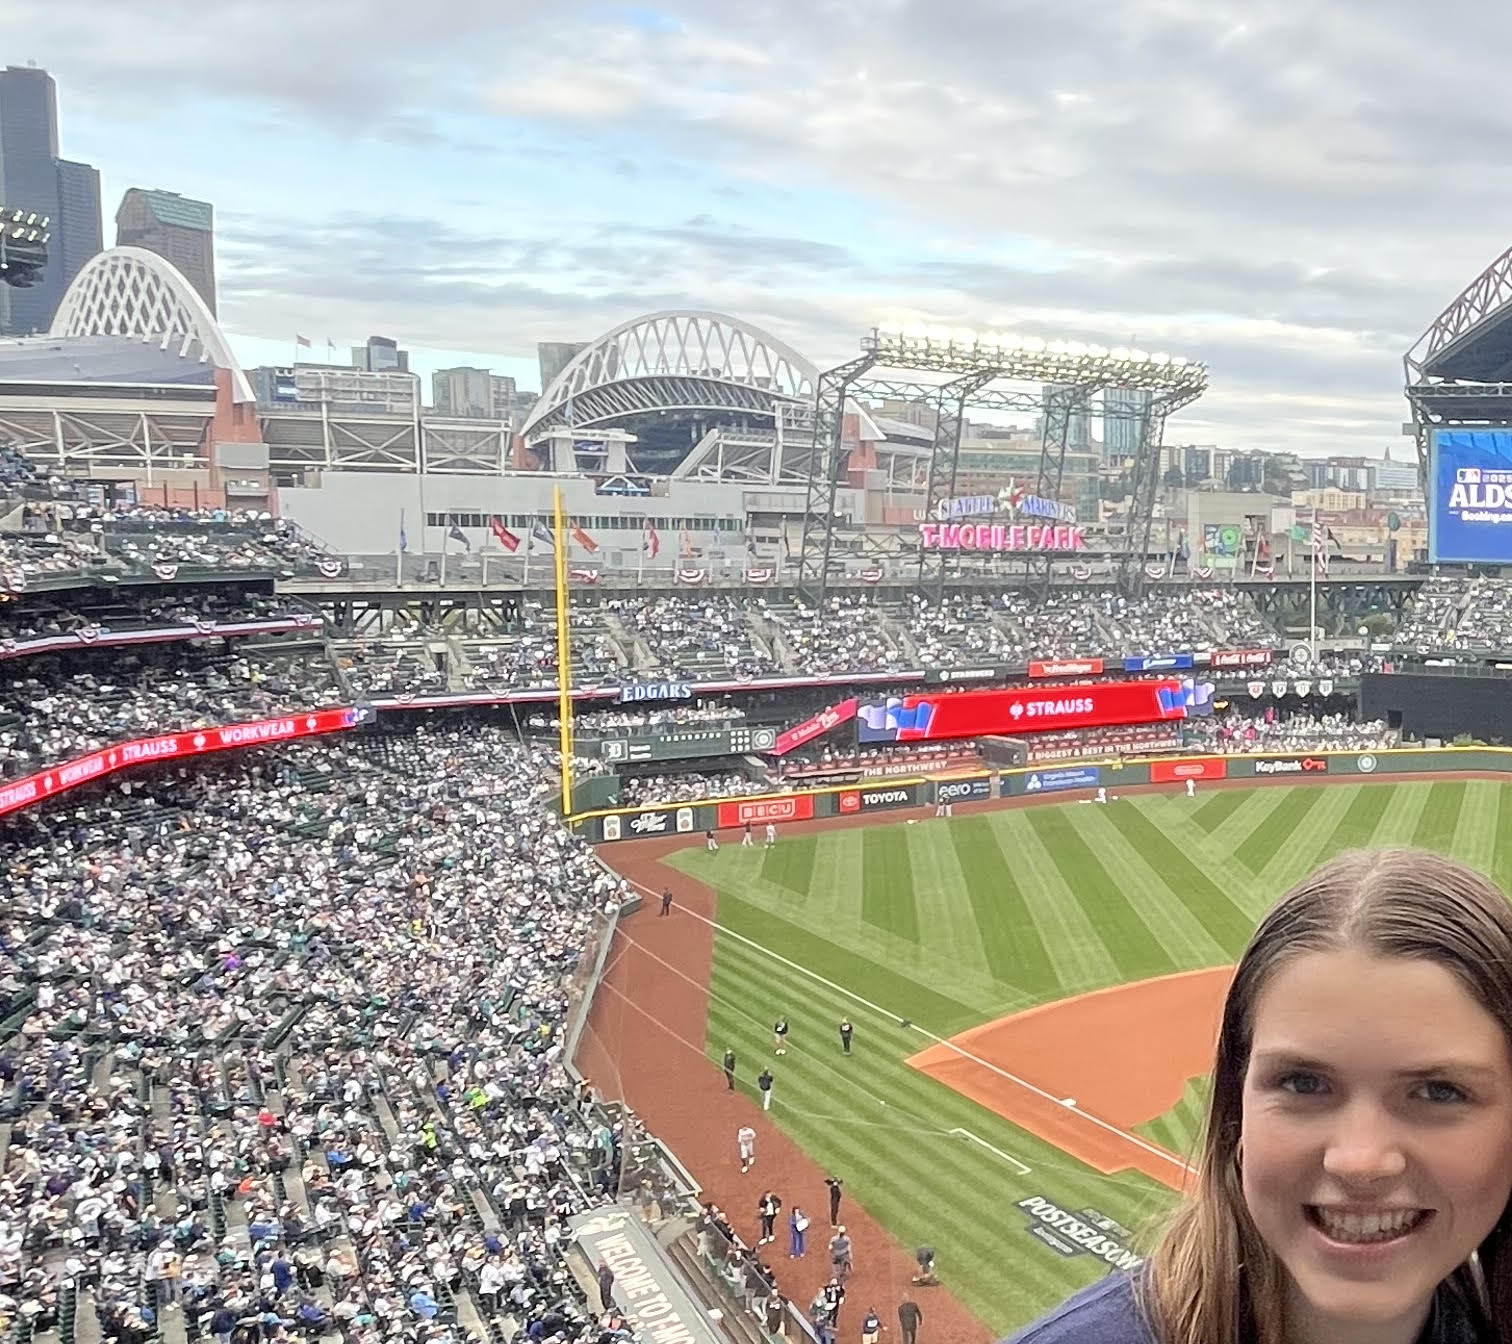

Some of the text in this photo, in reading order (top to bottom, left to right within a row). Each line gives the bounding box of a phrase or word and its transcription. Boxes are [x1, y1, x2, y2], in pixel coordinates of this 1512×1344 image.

[919, 524, 1086, 551] T-MOBILE PARK
[622, 683, 692, 703] EDGARS
[1026, 698, 1093, 717] STRAUSS
[59, 756, 104, 785] WORKWEAR
[123, 738, 177, 761] STRAUSS
[219, 720, 295, 745] WORKWEAR
[863, 760, 948, 777] THE NORTHWEST
[1256, 760, 1302, 774] KeyBank
[863, 790, 908, 805] TOYOTA
[939, 783, 971, 797] eero
[1018, 1196, 1144, 1271] POSTSEASON
[595, 1232, 660, 1299] WELCOME
[634, 1293, 672, 1319] TO
